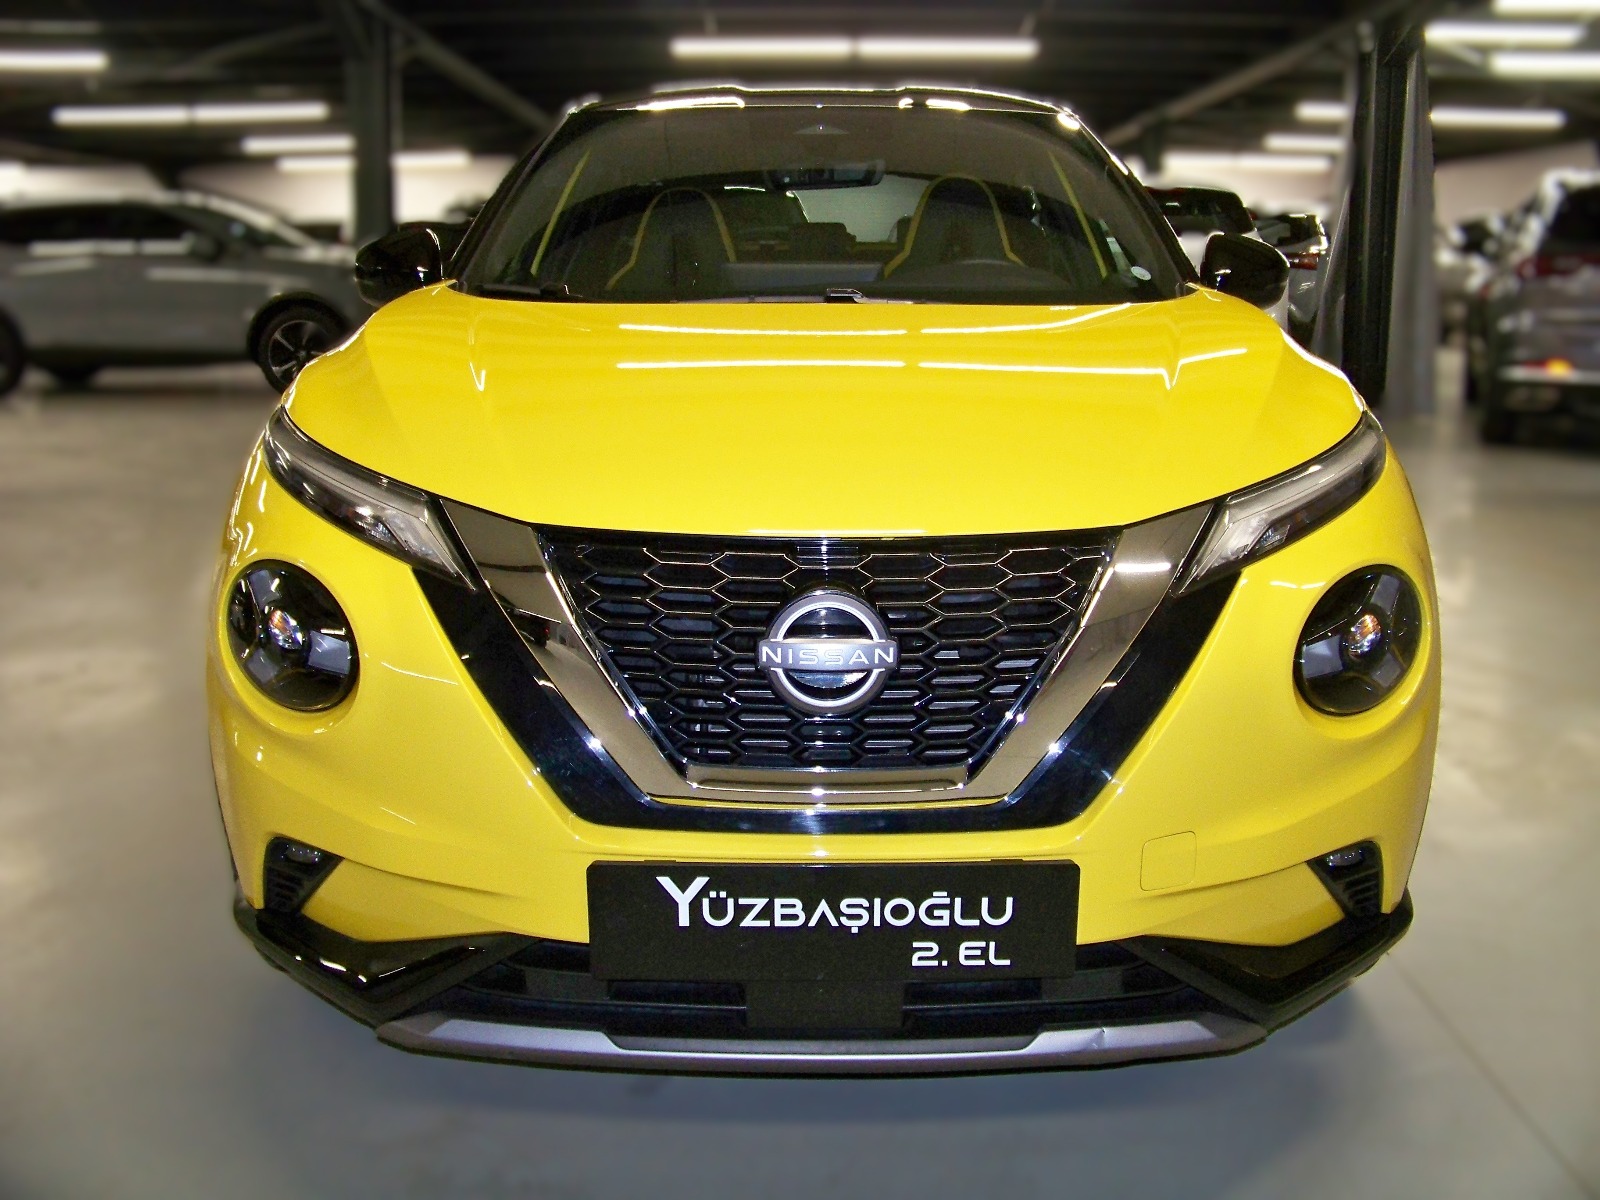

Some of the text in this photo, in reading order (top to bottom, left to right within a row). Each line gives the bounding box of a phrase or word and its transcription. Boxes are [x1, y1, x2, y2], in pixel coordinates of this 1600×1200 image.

[761, 646, 895, 666] NISSAN
[655, 876, 1014, 934] YÜZBAŞIOĞLU
[911, 941, 1011, 967] 2. EL
